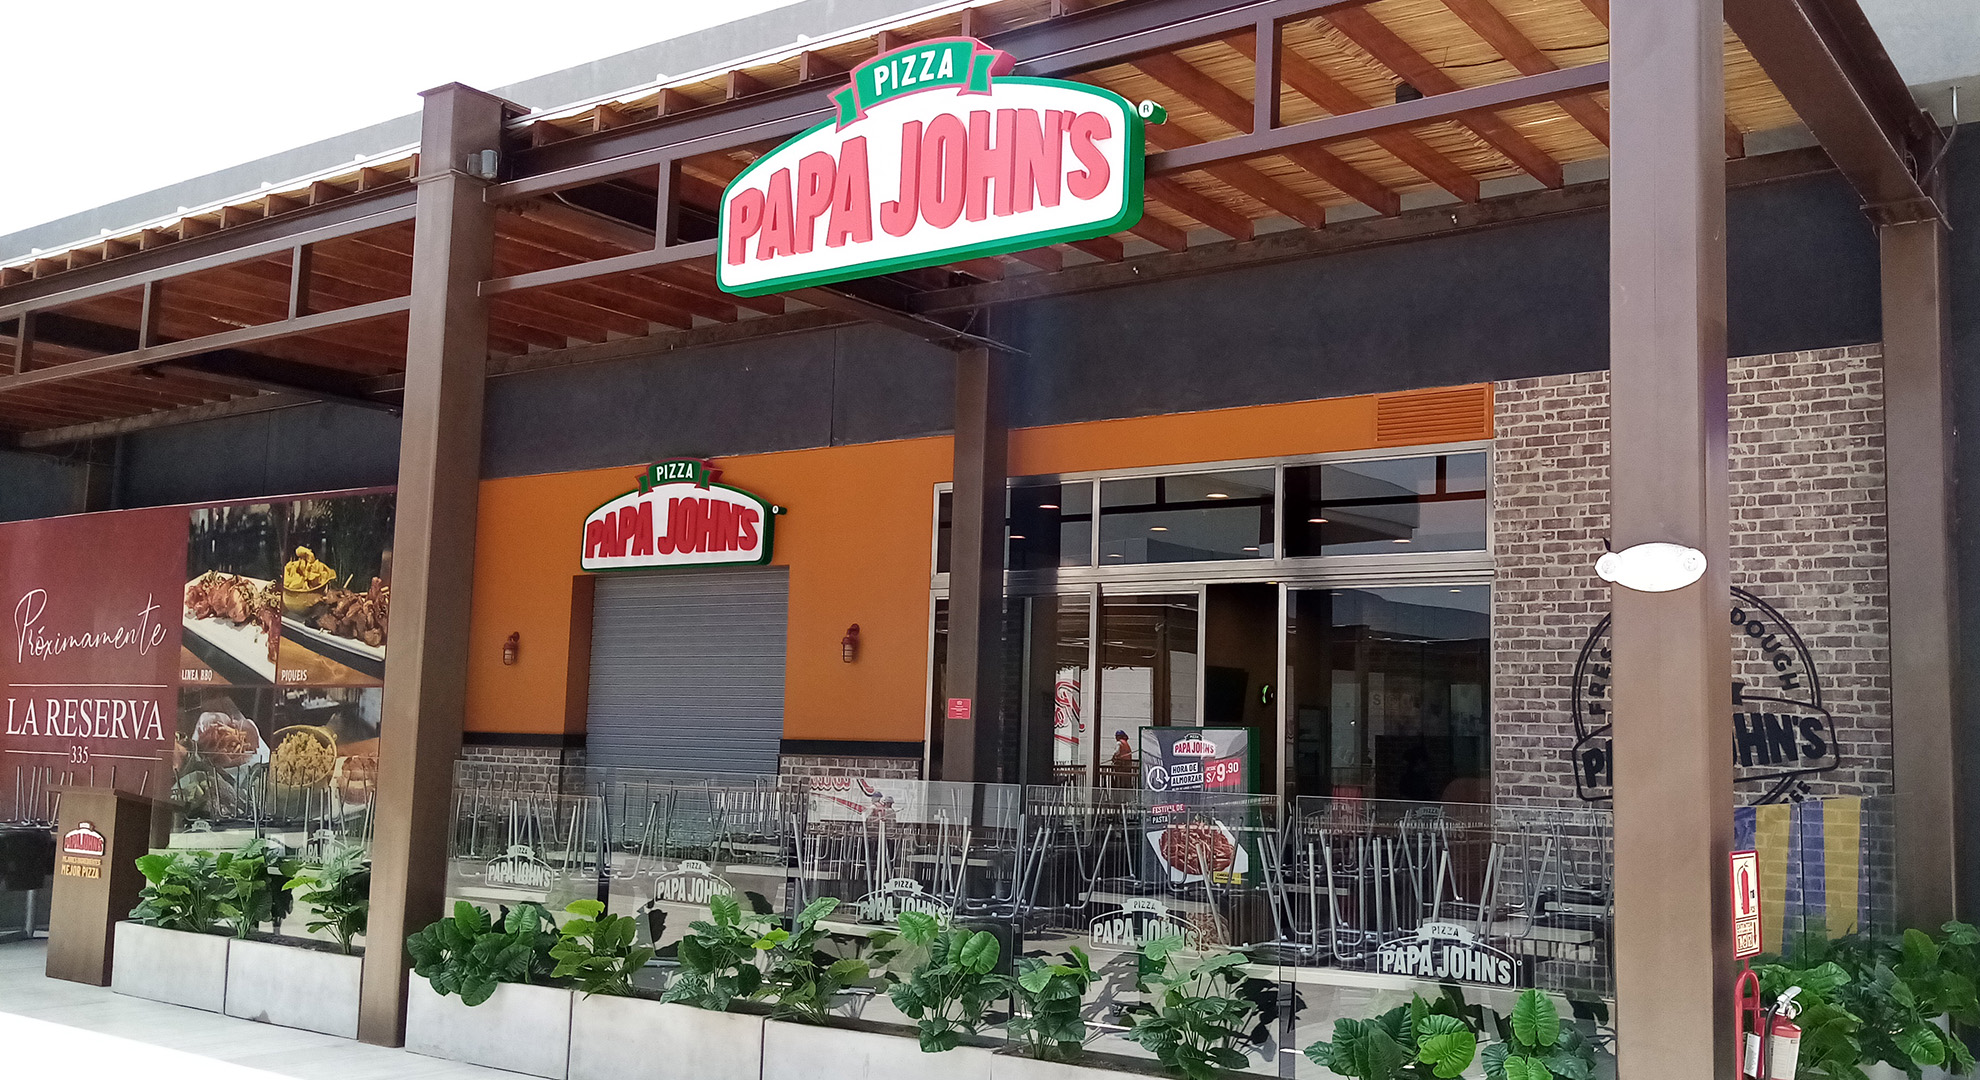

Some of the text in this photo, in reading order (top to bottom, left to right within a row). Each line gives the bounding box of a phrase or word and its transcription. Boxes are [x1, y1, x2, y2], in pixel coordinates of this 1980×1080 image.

[873, 47, 955, 97] PIZZA
[727, 107, 1112, 266] PAPA JOHN'S
[656, 462, 694, 482] PIZZA
[584, 497, 760, 559] PAPA JOHN'S
[14, 588, 168, 664] Próximamente
[1731, 607, 1800, 691] DOUGH
[5, 698, 166, 742] LA RESERVA
[1733, 711, 1828, 769] HN'S
[70, 745, 90, 765] 335
[1172, 765, 1188, 774] HORA
[1172, 774, 1203, 785] ALMORZAR
[1152, 815, 1169, 824] PASTA
[81, 867, 100, 879] PIZZA
[488, 861, 514, 883] PAPA
[657, 877, 686, 901] PAPA
[894, 879, 915, 890] PIZZA
[860, 896, 894, 921] PAPA
[1133, 900, 1157, 911] PIZZA
[1093, 917, 1136, 947] PAPA
[1431, 925, 1461, 937] PIZZA
[1382, 945, 1512, 985] PAPA JOHN'S
